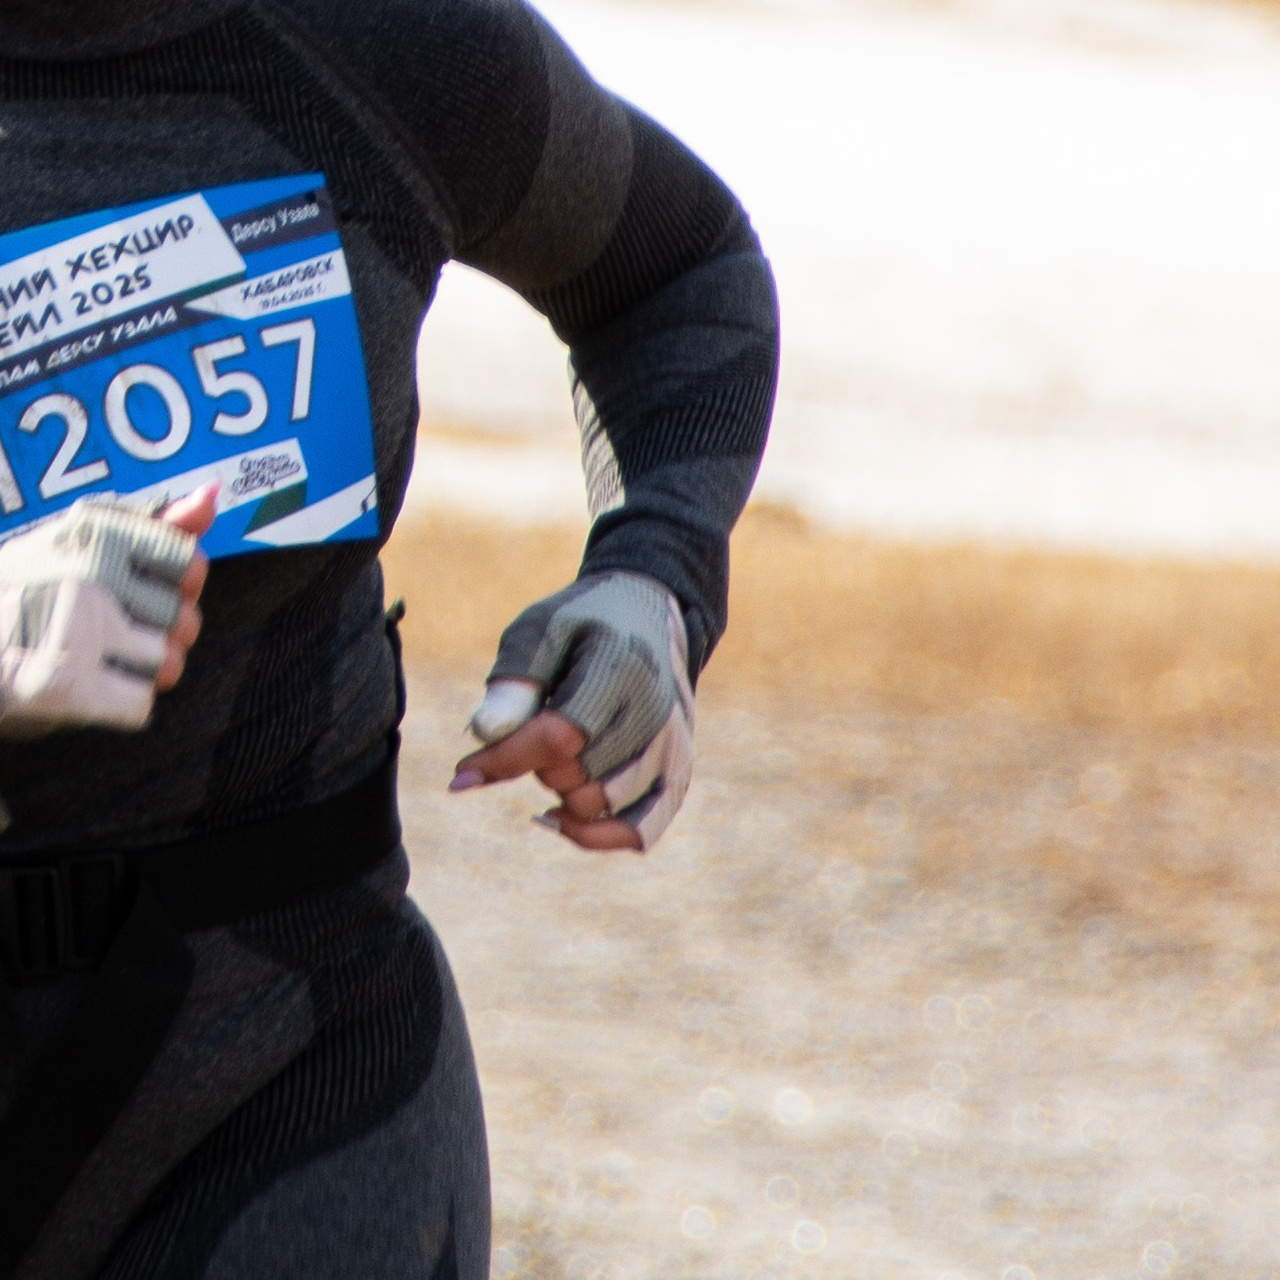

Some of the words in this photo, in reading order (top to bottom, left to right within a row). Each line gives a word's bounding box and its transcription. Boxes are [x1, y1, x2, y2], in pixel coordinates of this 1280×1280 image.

[65, 214, 195, 281] ХЕХЦИР
[70, 262, 153, 317] 2025
[45, 330, 105, 369] ДЕРСУ
[109, 304, 179, 344] УЗАЛА
